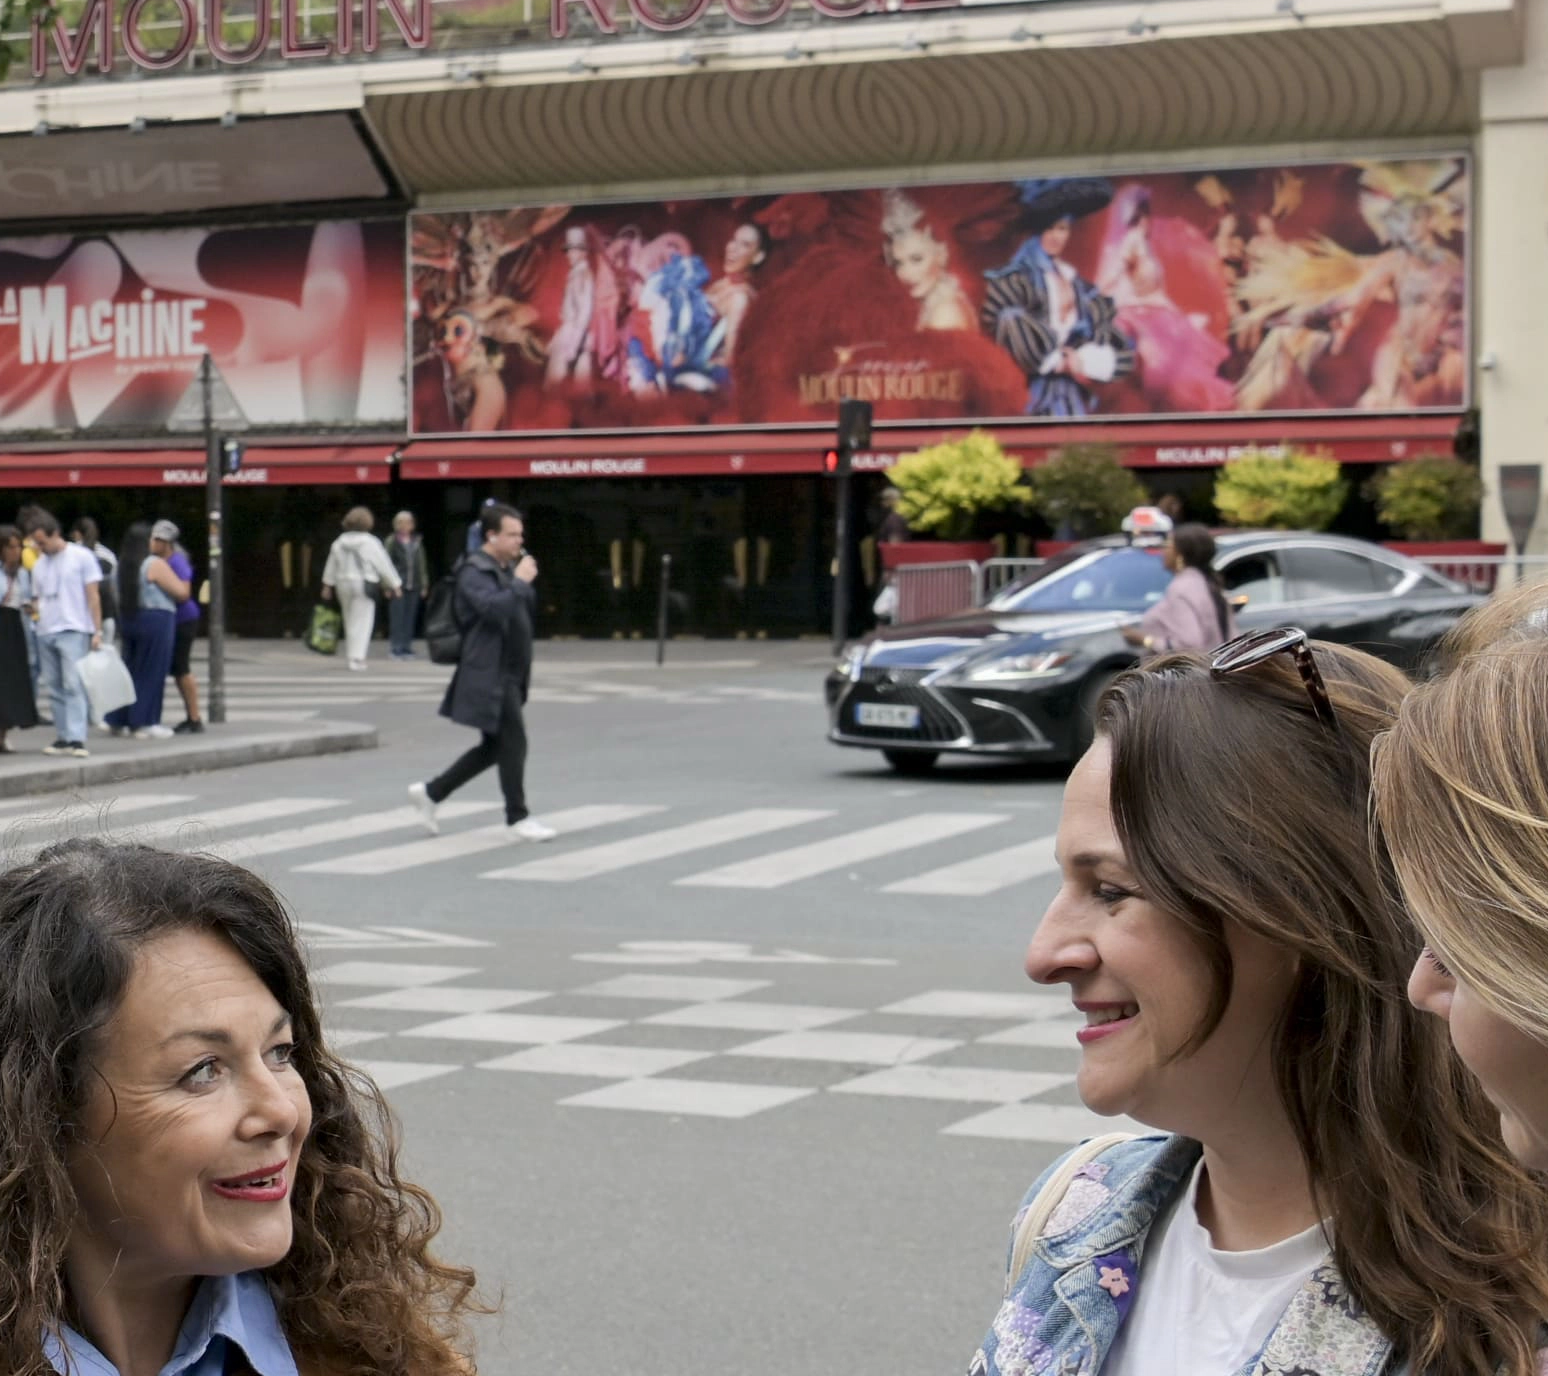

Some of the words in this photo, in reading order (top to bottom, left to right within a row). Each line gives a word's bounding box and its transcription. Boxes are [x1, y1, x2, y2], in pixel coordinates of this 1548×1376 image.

[799, 372, 882, 405] MOULIN
[884, 369, 964, 401] ROUGE
[530, 460, 588, 475] MOULIN
[590, 458, 647, 473] ROUGE
[162, 470, 207, 483] MOULI
